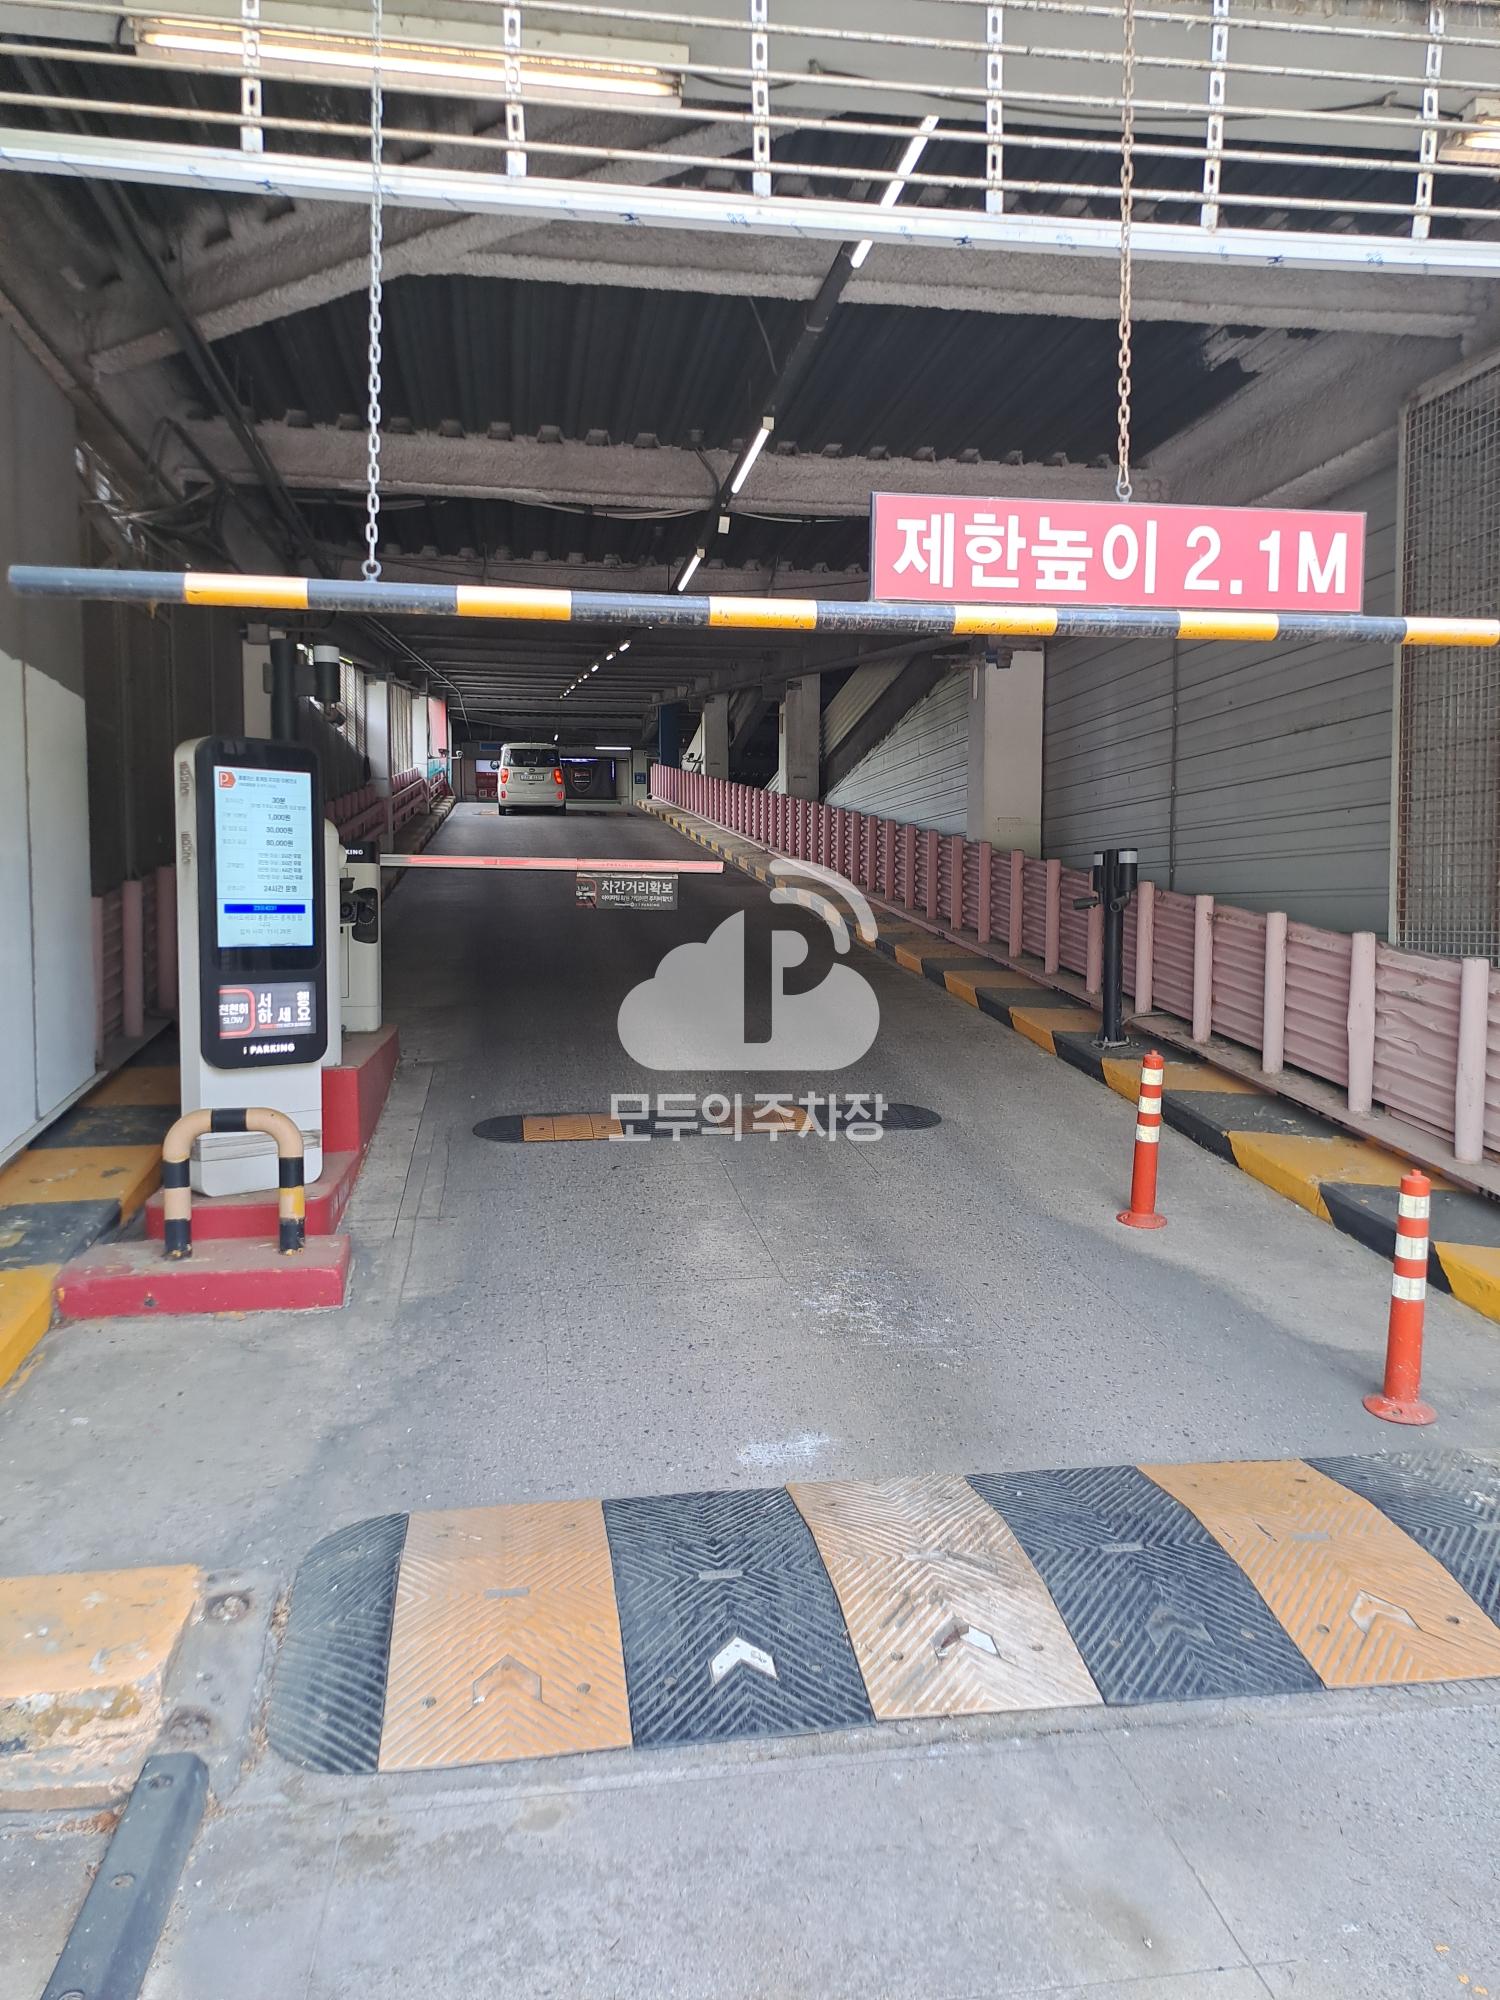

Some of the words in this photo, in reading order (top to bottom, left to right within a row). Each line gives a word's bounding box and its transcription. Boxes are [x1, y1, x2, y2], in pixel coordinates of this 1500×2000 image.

[892, 512, 1157, 595] 제한높이
[1182, 525, 1348, 596] 2.1M
[601, 880, 674, 895] 차간거리확보
[223, 1016, 244, 1024] SLOW
[249, 1043, 295, 1055] PARKING
